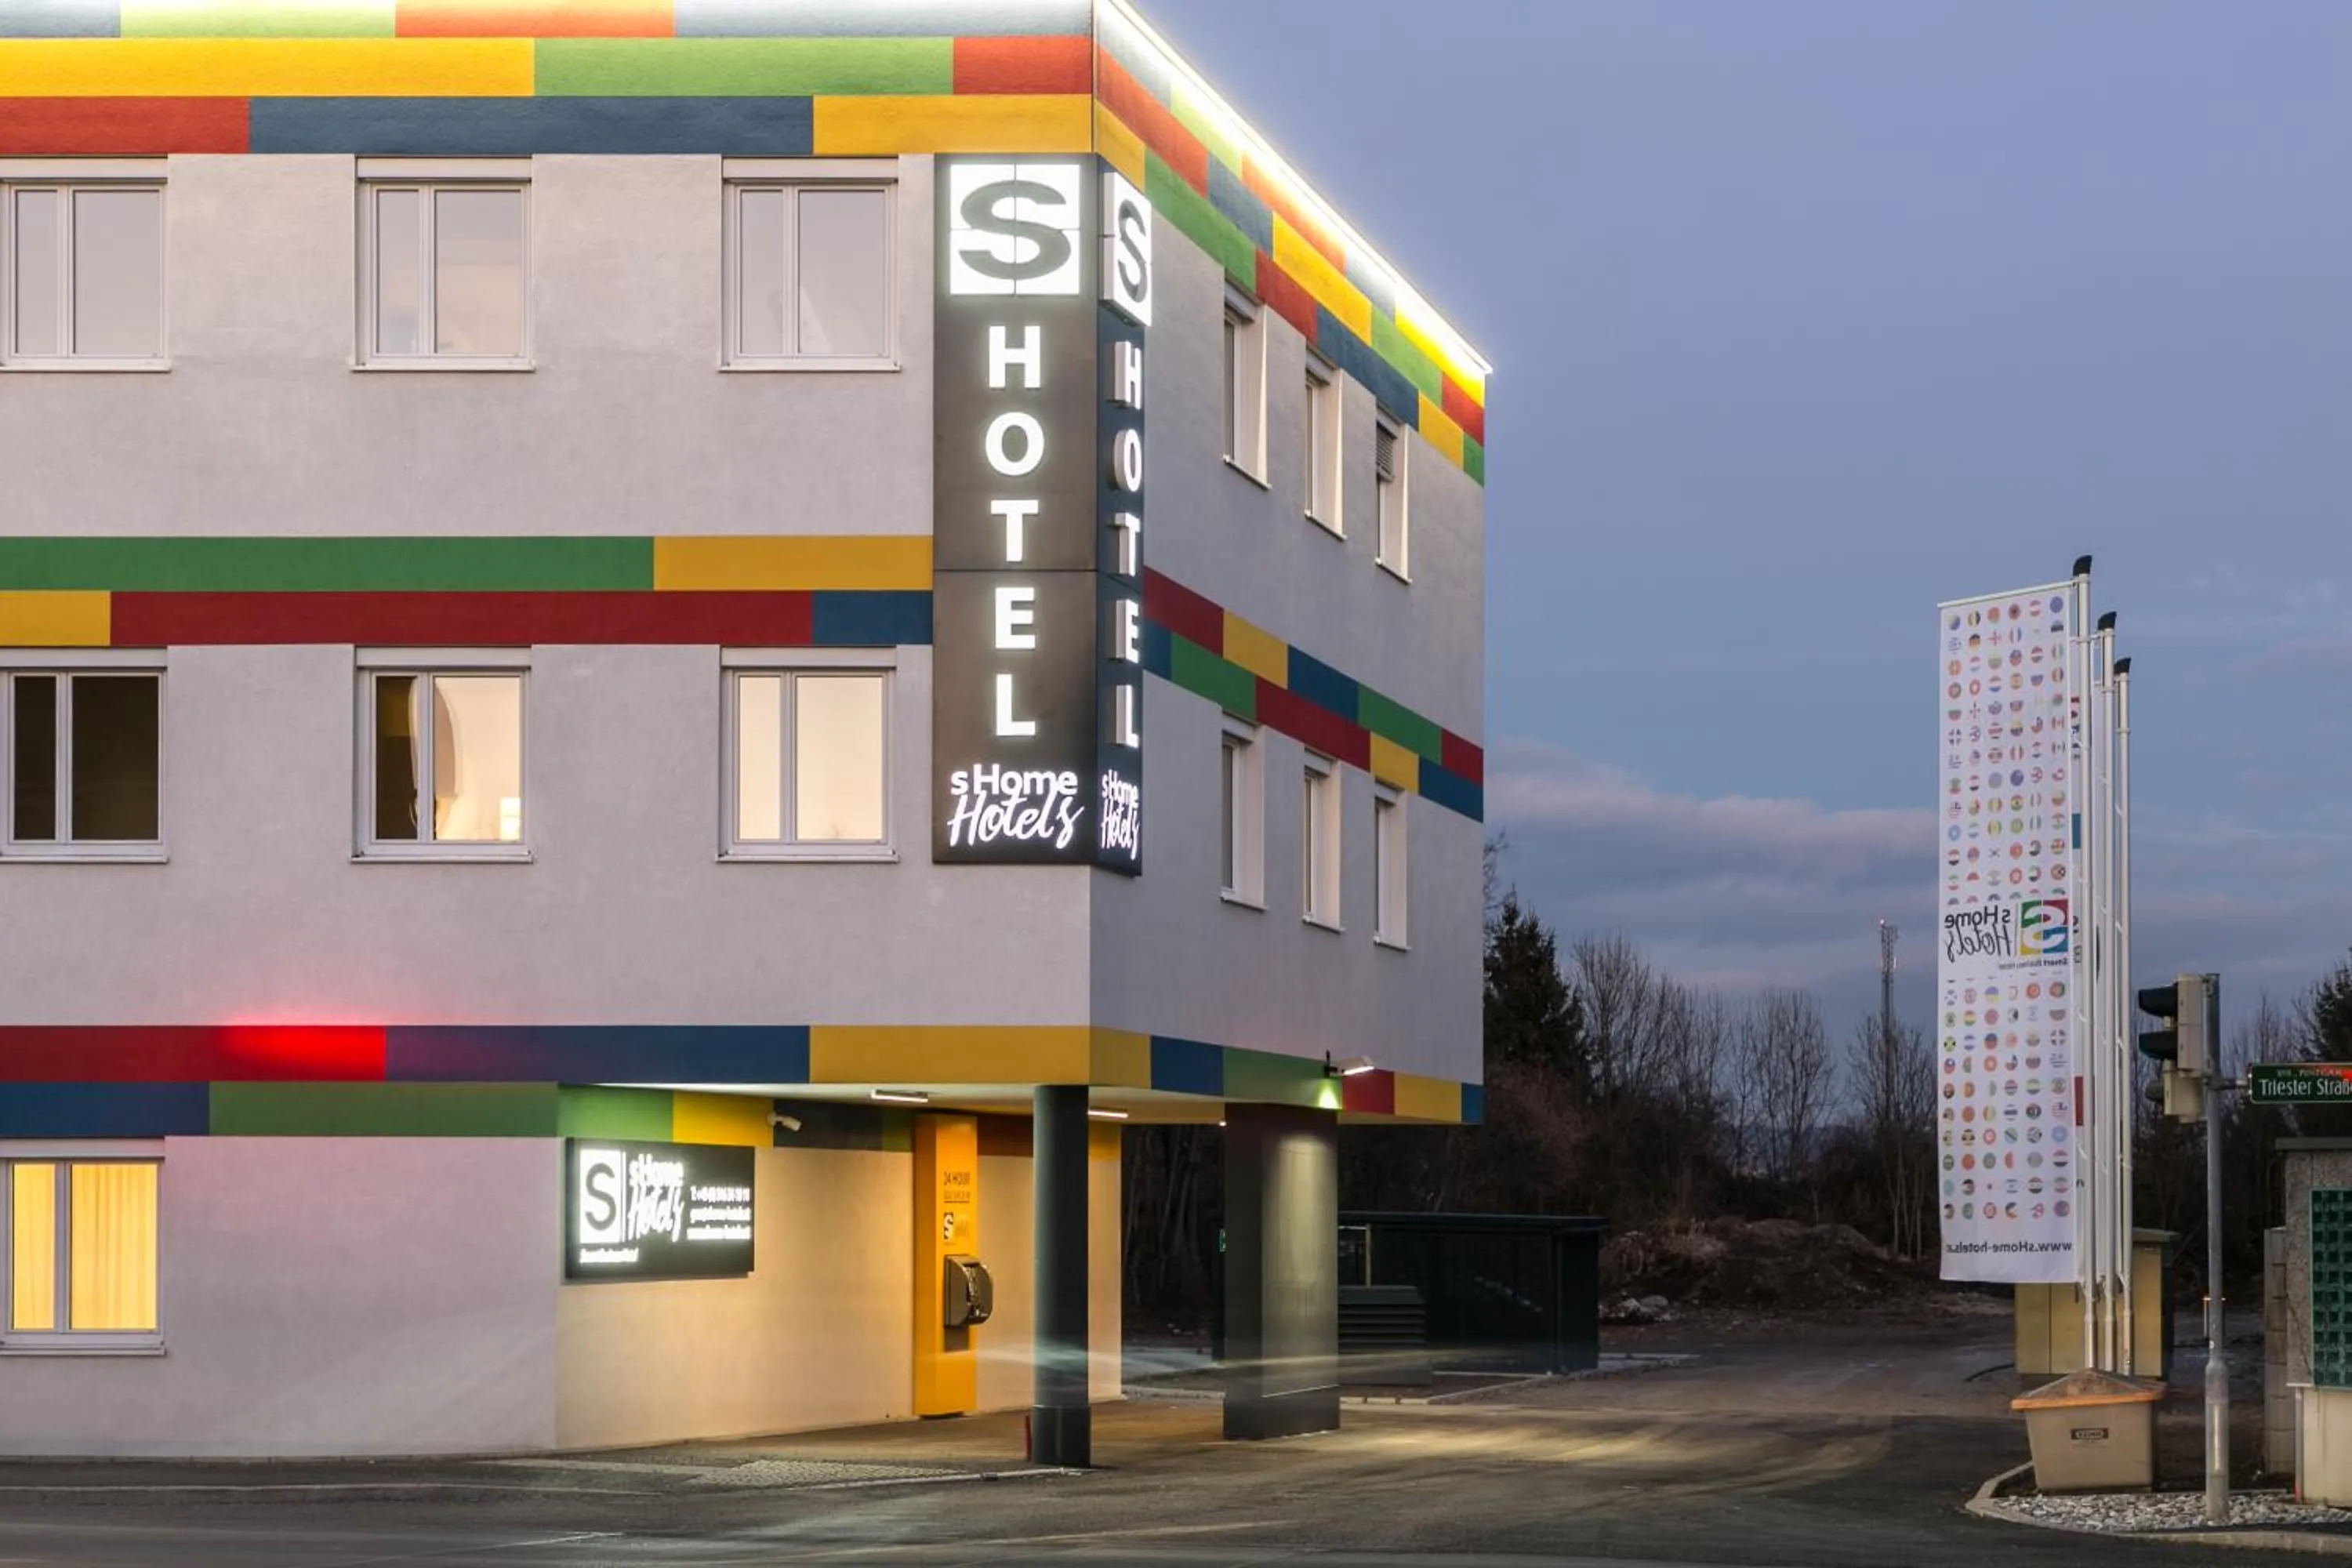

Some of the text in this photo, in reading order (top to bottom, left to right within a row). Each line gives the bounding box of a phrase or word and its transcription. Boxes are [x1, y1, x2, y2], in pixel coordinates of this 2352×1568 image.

[958, 179, 1072, 280] S
[1118, 198, 1148, 303] S
[985, 325, 1045, 736] HOTEL
[1116, 342, 1142, 748] HOTEL
[947, 789, 1084, 849] Hotels
[950, 764, 1078, 796] sHome
[2259, 1078, 2311, 1096] Triester
[585, 1163, 617, 1231] S
